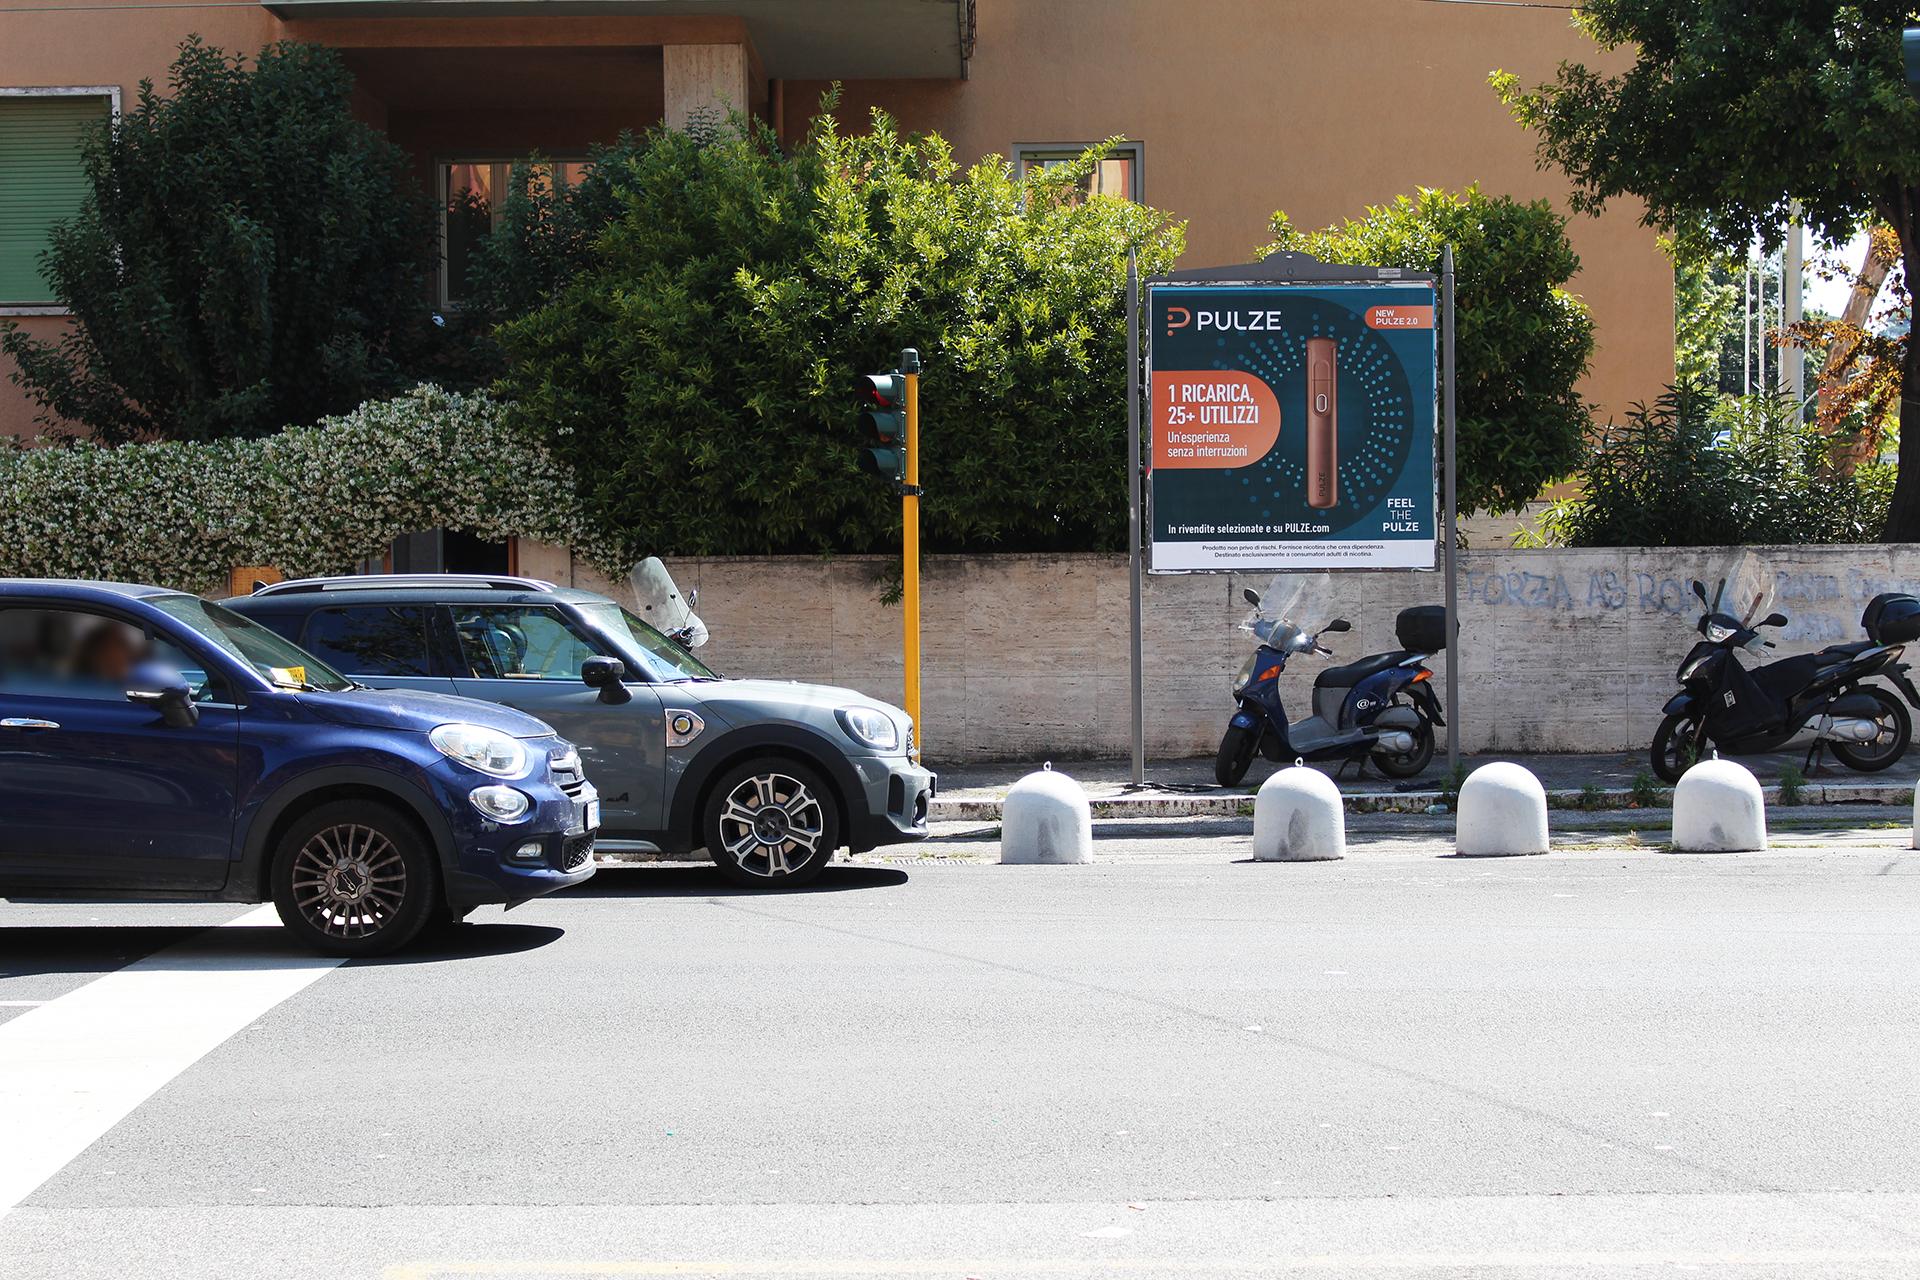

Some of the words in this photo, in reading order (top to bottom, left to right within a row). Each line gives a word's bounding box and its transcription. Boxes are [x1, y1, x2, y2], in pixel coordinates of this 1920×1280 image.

[1197, 311, 1281, 331] PULZE
[1168, 384, 1175, 403] 1
[1182, 384, 1254, 404] RICARICA,
[1168, 406, 1196, 425] 25+
[1200, 406, 1259, 424] UTILIZZI
[1167, 431, 1230, 446] Un'esperienza
[1167, 447, 1194, 458] senza
[1197, 445, 1248, 457] interruzioni
[1387, 498, 1415, 508] FEEL
[1390, 510, 1411, 520] THE
[1168, 524, 1176, 534] In
[1178, 524, 1215, 534] rivendite
[1217, 523, 1264, 534] selezionate
[1273, 525, 1283, 533] su
[1285, 523, 1330, 533] PULZE.com
[1382, 522, 1419, 532] PULZE
[1466, 570, 1574, 611] FORZA
